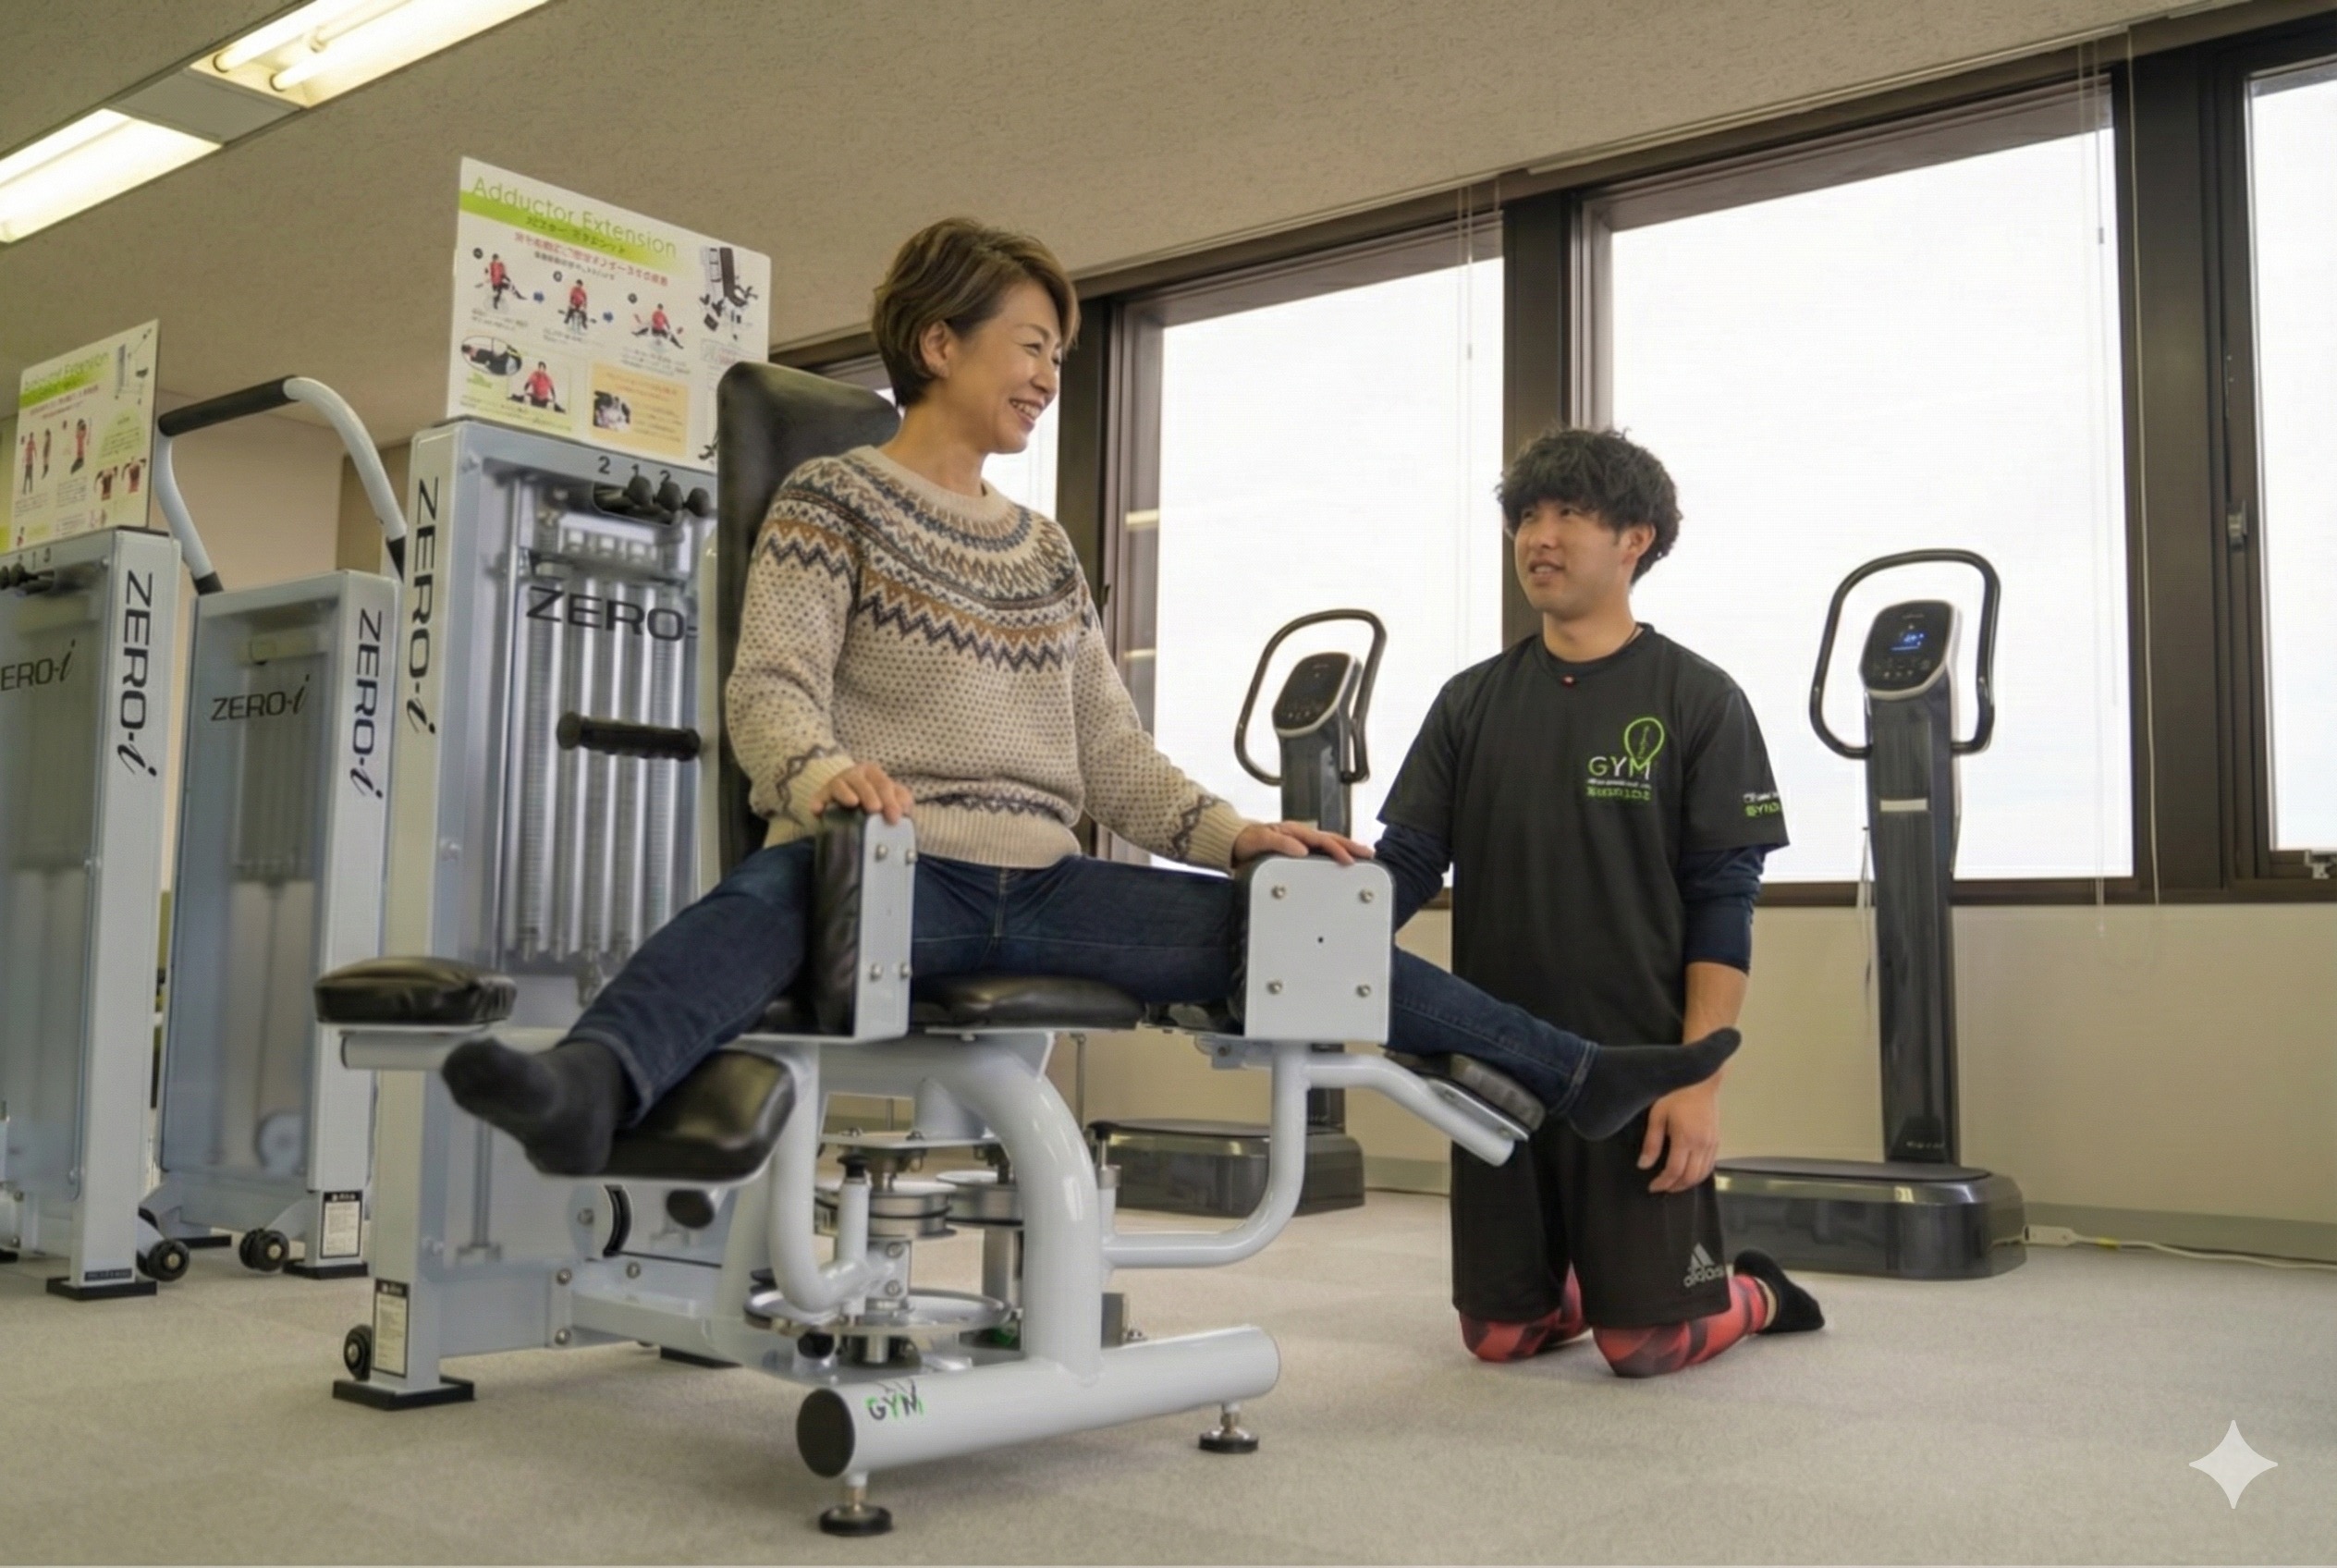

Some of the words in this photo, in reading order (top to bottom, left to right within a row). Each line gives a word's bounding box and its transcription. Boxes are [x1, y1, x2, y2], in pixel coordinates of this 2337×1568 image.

[471, 176, 575, 223] Adductor
[581, 211, 677, 259] Extension
[598, 455, 612, 475] 2
[1587, 754, 1652, 781] GYM
[864, 1387, 924, 1421] GYM
